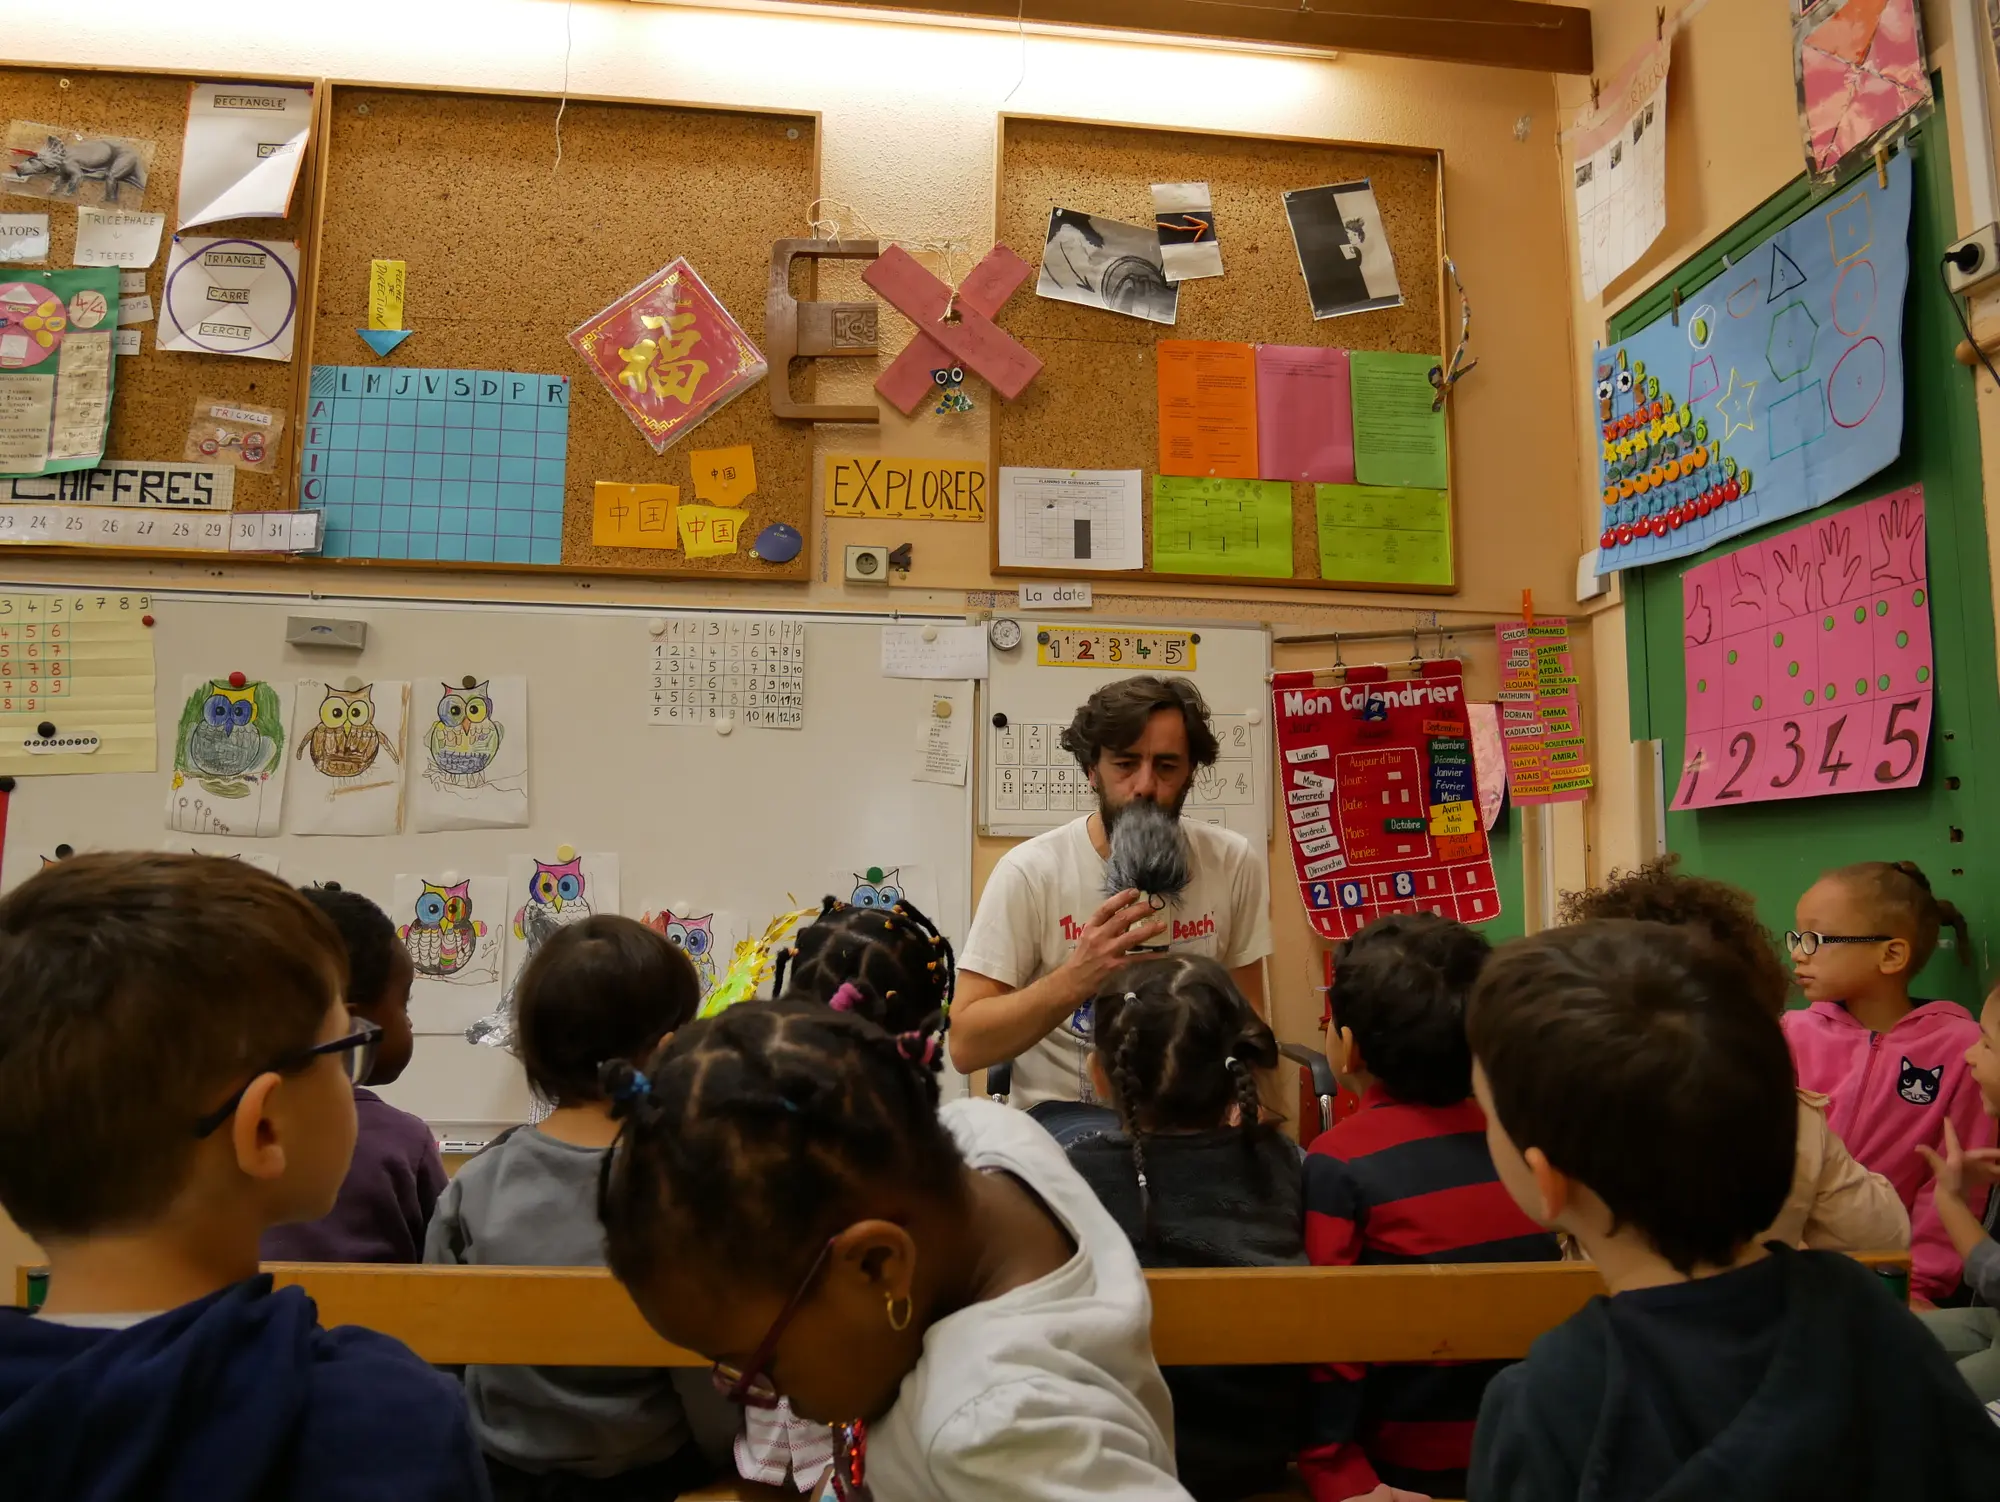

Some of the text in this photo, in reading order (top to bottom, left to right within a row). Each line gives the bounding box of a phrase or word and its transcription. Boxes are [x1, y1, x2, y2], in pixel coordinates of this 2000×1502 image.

[215, 97, 283, 108] RECTANGLE
[85, 213, 157, 226] TRICEPHALE
[84, 249, 135, 262] 3 TETES
[207, 254, 266, 266] TRIANGLE
[210, 289, 249, 301] CARRE
[75, 293, 106, 323] 4/4
[201, 324, 250, 338] CERCLE
[618, 312, 710, 405] 福
[342, 373, 563, 403] L M J V S D P R
[1648, 376, 1659, 398] 3
[214, 408, 269, 423] TRICYCLE
[312, 401, 328, 418] A
[310, 427, 322, 445] E
[311, 454, 317, 473] I
[711, 466, 736, 482] 中国
[834, 459, 985, 513] EXPLORER
[1739, 469, 1752, 494] 9
[304, 478, 322, 500] O
[609, 497, 668, 533] 中国
[0, 515, 282, 538] 23 24 25 26 27 28 29 30 31
[687, 516, 734, 544] 中国
[1025, 586, 1086, 602] La date
[0, 597, 149, 614] 3 4 5 6 7 8 9
[1, 624, 61, 639] 4 5 6
[673, 622, 803, 638] 1 2 3 4 5 6 7 8
[1502, 630, 1526, 640] CHLOE
[1050, 638, 1182, 664] 1 2 3 4 5
[1537, 645, 1568, 656] DAPHNE
[1507, 660, 1529, 668] HUGO
[1538, 658, 1557, 666] PAUL
[1538, 667, 1563, 675] AFDAL
[1505, 681, 1534, 689] ELOUAN
[1498, 692, 1531, 700] MATHURIN
[1540, 688, 1568, 696] HARON
[1283, 691, 1332, 718] Mon
[1504, 711, 1533, 719] DORIAN
[1542, 709, 1567, 718] EMMA
[1005, 726, 1011, 736] 1
[1031, 726, 1039, 736] 2
[1233, 725, 1246, 747] 2
[1505, 726, 1542, 736] KADIATOU
[1432, 741, 1465, 750] Novembre
[1510, 744, 1540, 752] AMIROU
[1544, 738, 1585, 748] SOULEYMAN
[1296, 750, 1318, 762] Lundi
[1552, 752, 1577, 761] AMIRA
[1681, 697, 1922, 805] 1 2 3 4 5
[1513, 758, 1538, 767] NAIYA
[1004, 770, 1066, 781] 6 7 8
[1435, 767, 1463, 777] Janvier
[1516, 773, 1540, 781] ANAIS
[1235, 773, 1248, 794] 4
[1303, 776, 1323, 788] Mardi
[1436, 780, 1465, 791] Février
[1552, 779, 1591, 790] ANASTASIA
[1292, 790, 1325, 802] Mercredi
[1441, 792, 1461, 802] Mars
[1301, 808, 1320, 819] Jeudi
[1442, 803, 1462, 815] Avril
[1391, 819, 1421, 830] Octobre
[1444, 823, 1461, 833] Juin
[1297, 825, 1327, 839] Vendredi
[1306, 841, 1331, 853] Samedi
[1308, 859, 1343, 877] Dimanche
[1314, 873, 1412, 906] 2 0 8
[1173, 914, 1215, 939] Beach
